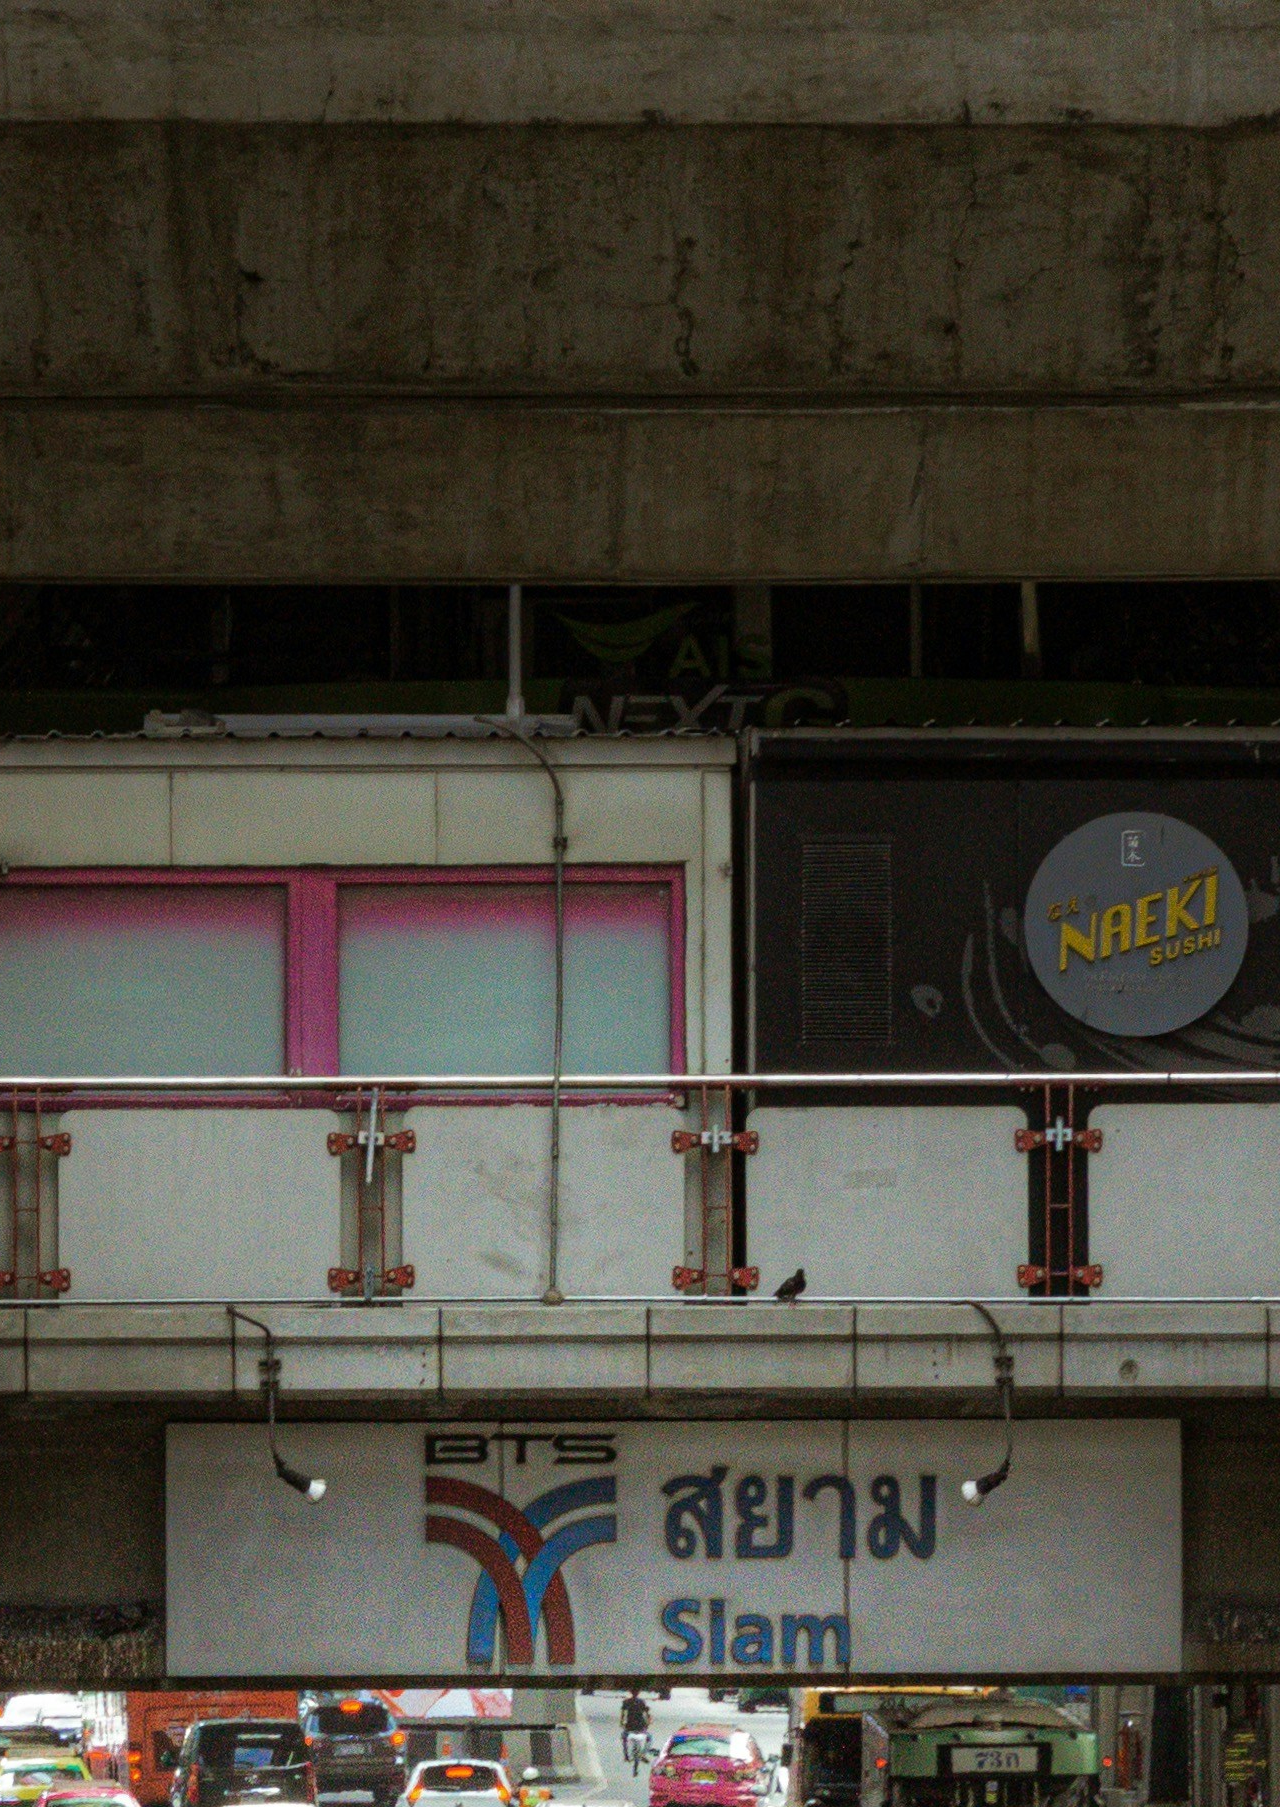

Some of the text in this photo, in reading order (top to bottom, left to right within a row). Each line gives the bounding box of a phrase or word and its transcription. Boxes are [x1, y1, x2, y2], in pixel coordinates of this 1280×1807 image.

[669, 634, 772, 679] AIS
[1058, 873, 1220, 973] NAEKI
[1149, 928, 1222, 967] SUSHI
[424, 1432, 618, 1466] BTS
[661, 1464, 938, 1561] สยาม
[660, 1597, 852, 1666] Siam
